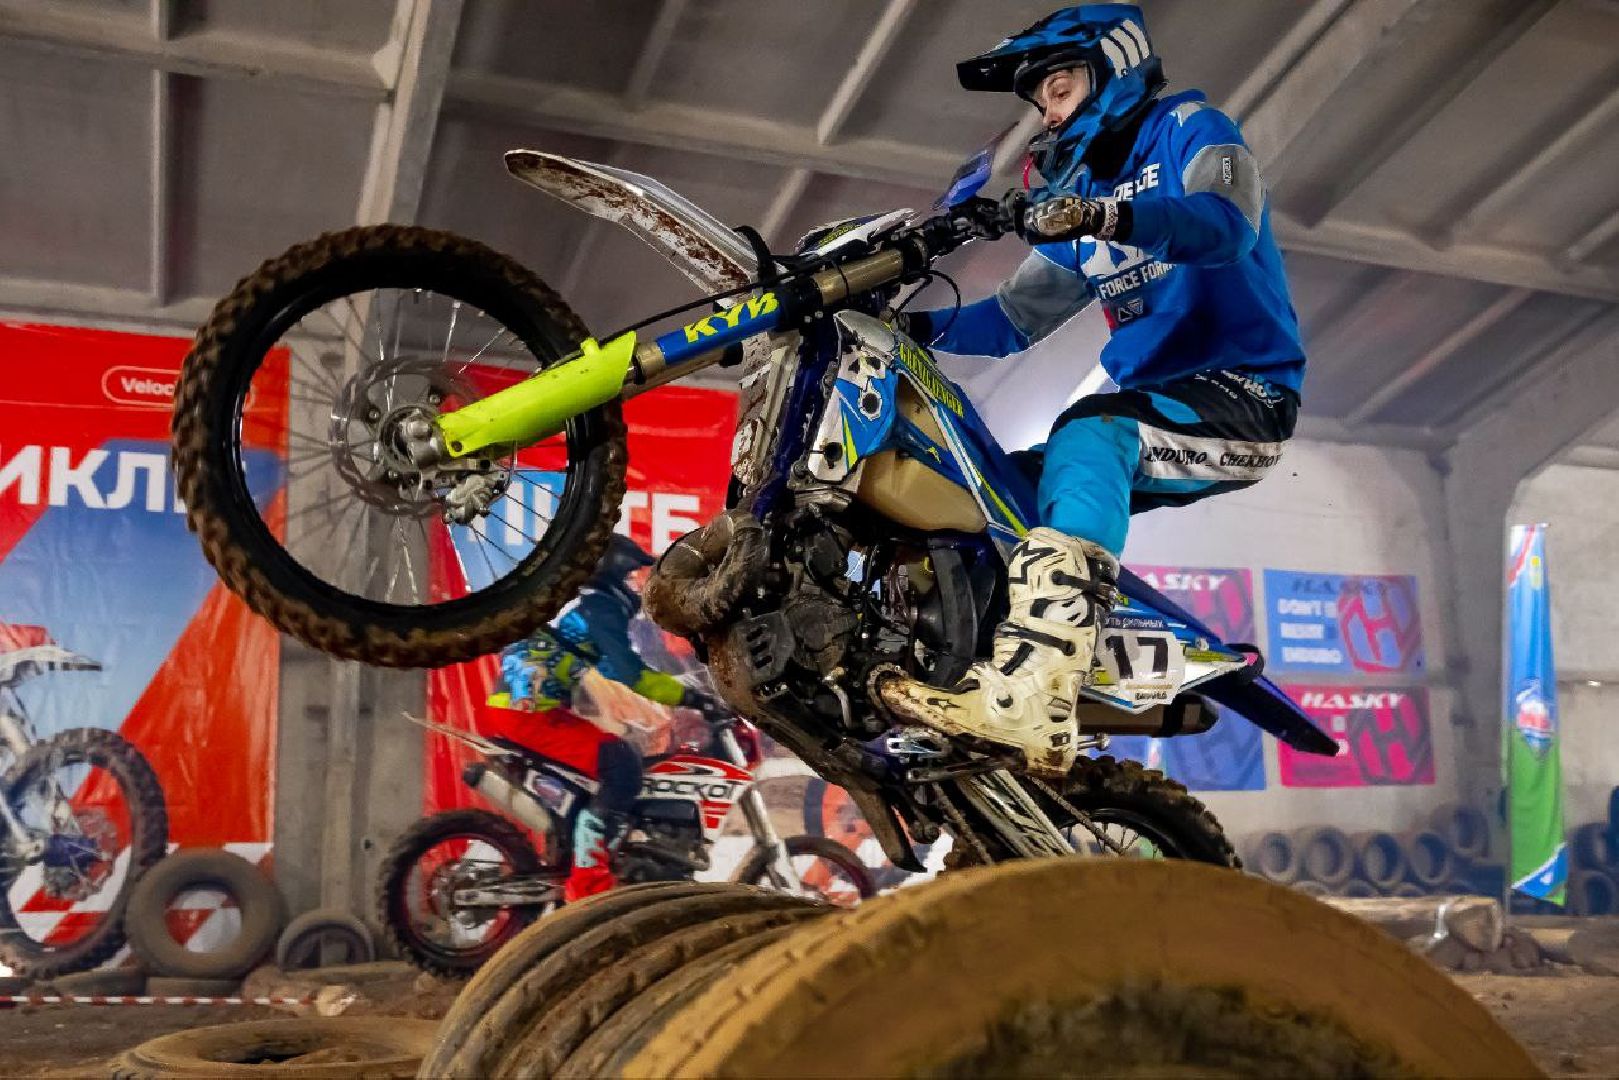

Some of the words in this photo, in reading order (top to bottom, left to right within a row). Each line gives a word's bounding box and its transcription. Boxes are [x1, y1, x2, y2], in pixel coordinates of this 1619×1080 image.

[1098, 270, 1141, 300] FORCE
[684, 292, 779, 343] KYB
[120, 376, 175, 396] Veloc
[0, 444, 189, 514] ИКЛ
[1131, 570, 1228, 591] ASKY
[1105, 635, 1169, 680] 17
[1301, 692, 1407, 709] HASKY
